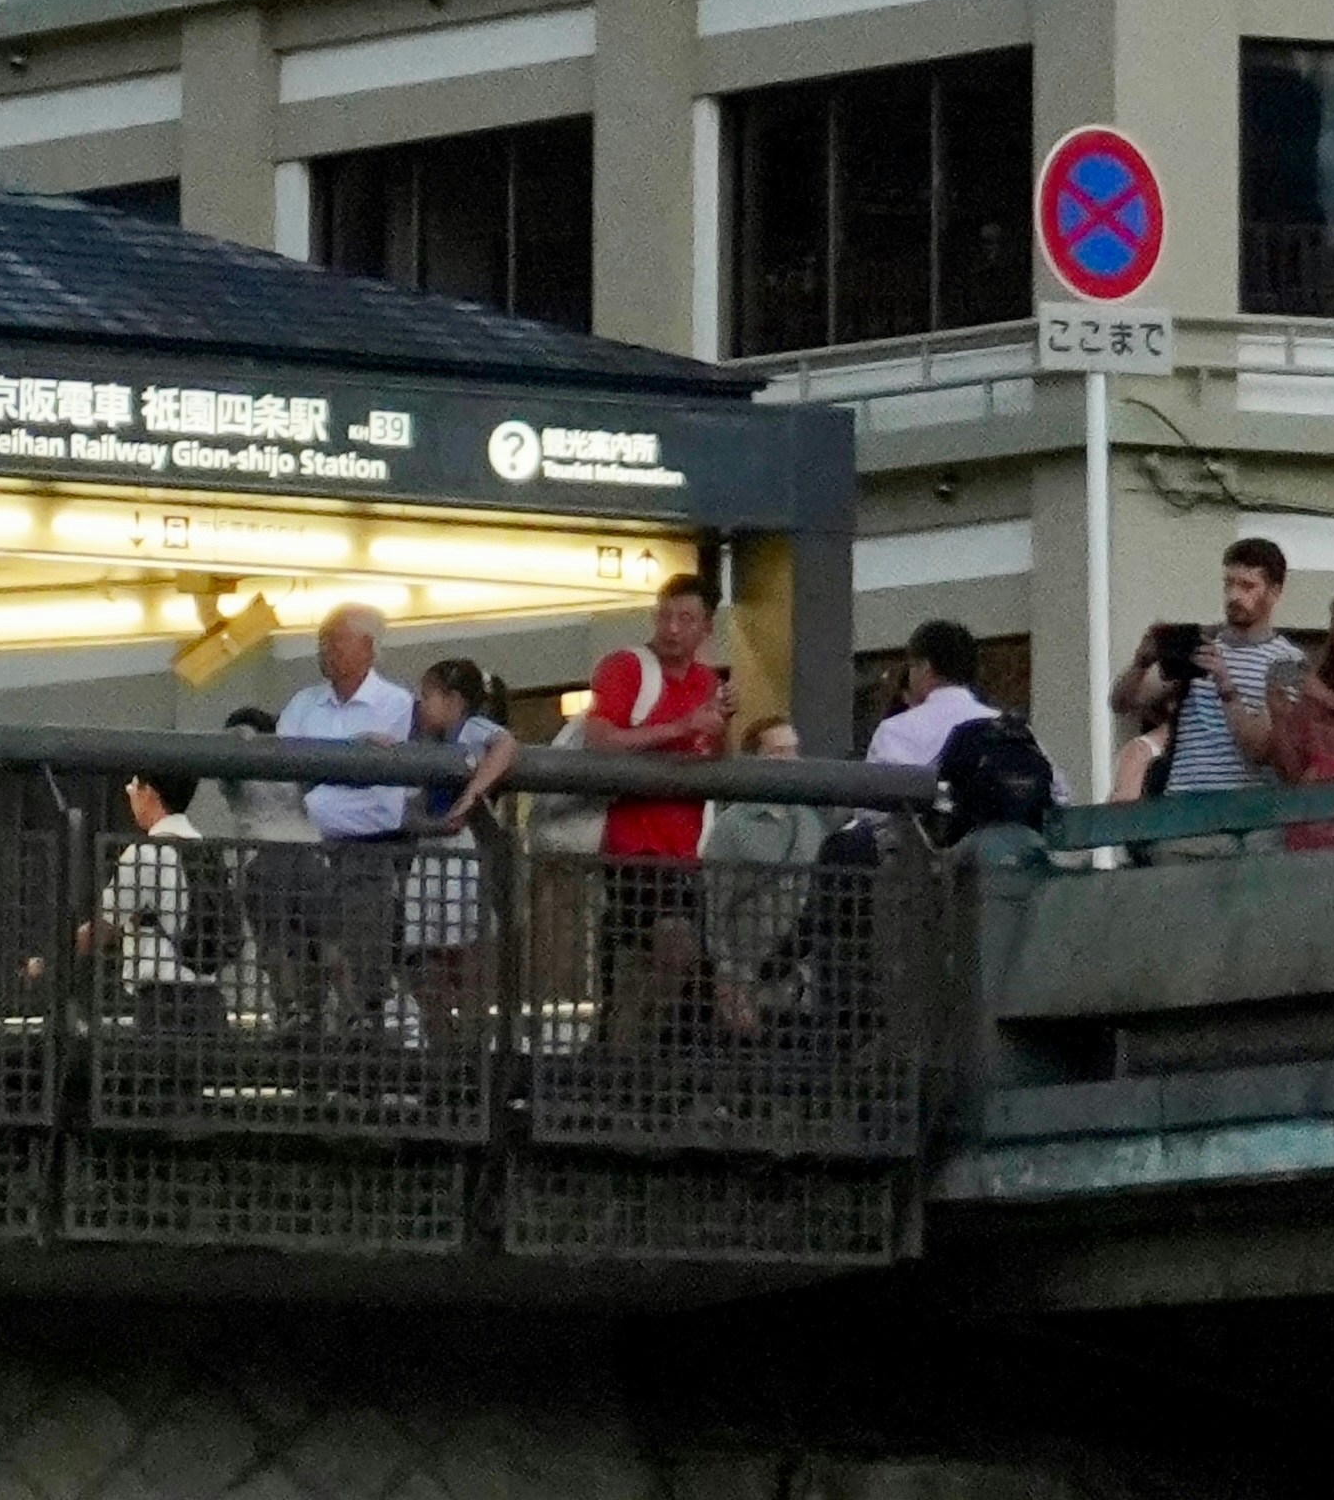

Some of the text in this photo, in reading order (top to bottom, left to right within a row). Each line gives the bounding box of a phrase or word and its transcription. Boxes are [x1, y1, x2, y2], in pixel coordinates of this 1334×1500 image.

[1048, 319, 1164, 356] ここまで
[70, 433, 168, 471] Railway
[172, 440, 295, 479] Gion-shijo
[299, 448, 387, 480] Station
[542, 460, 686, 486] Tourist Information
